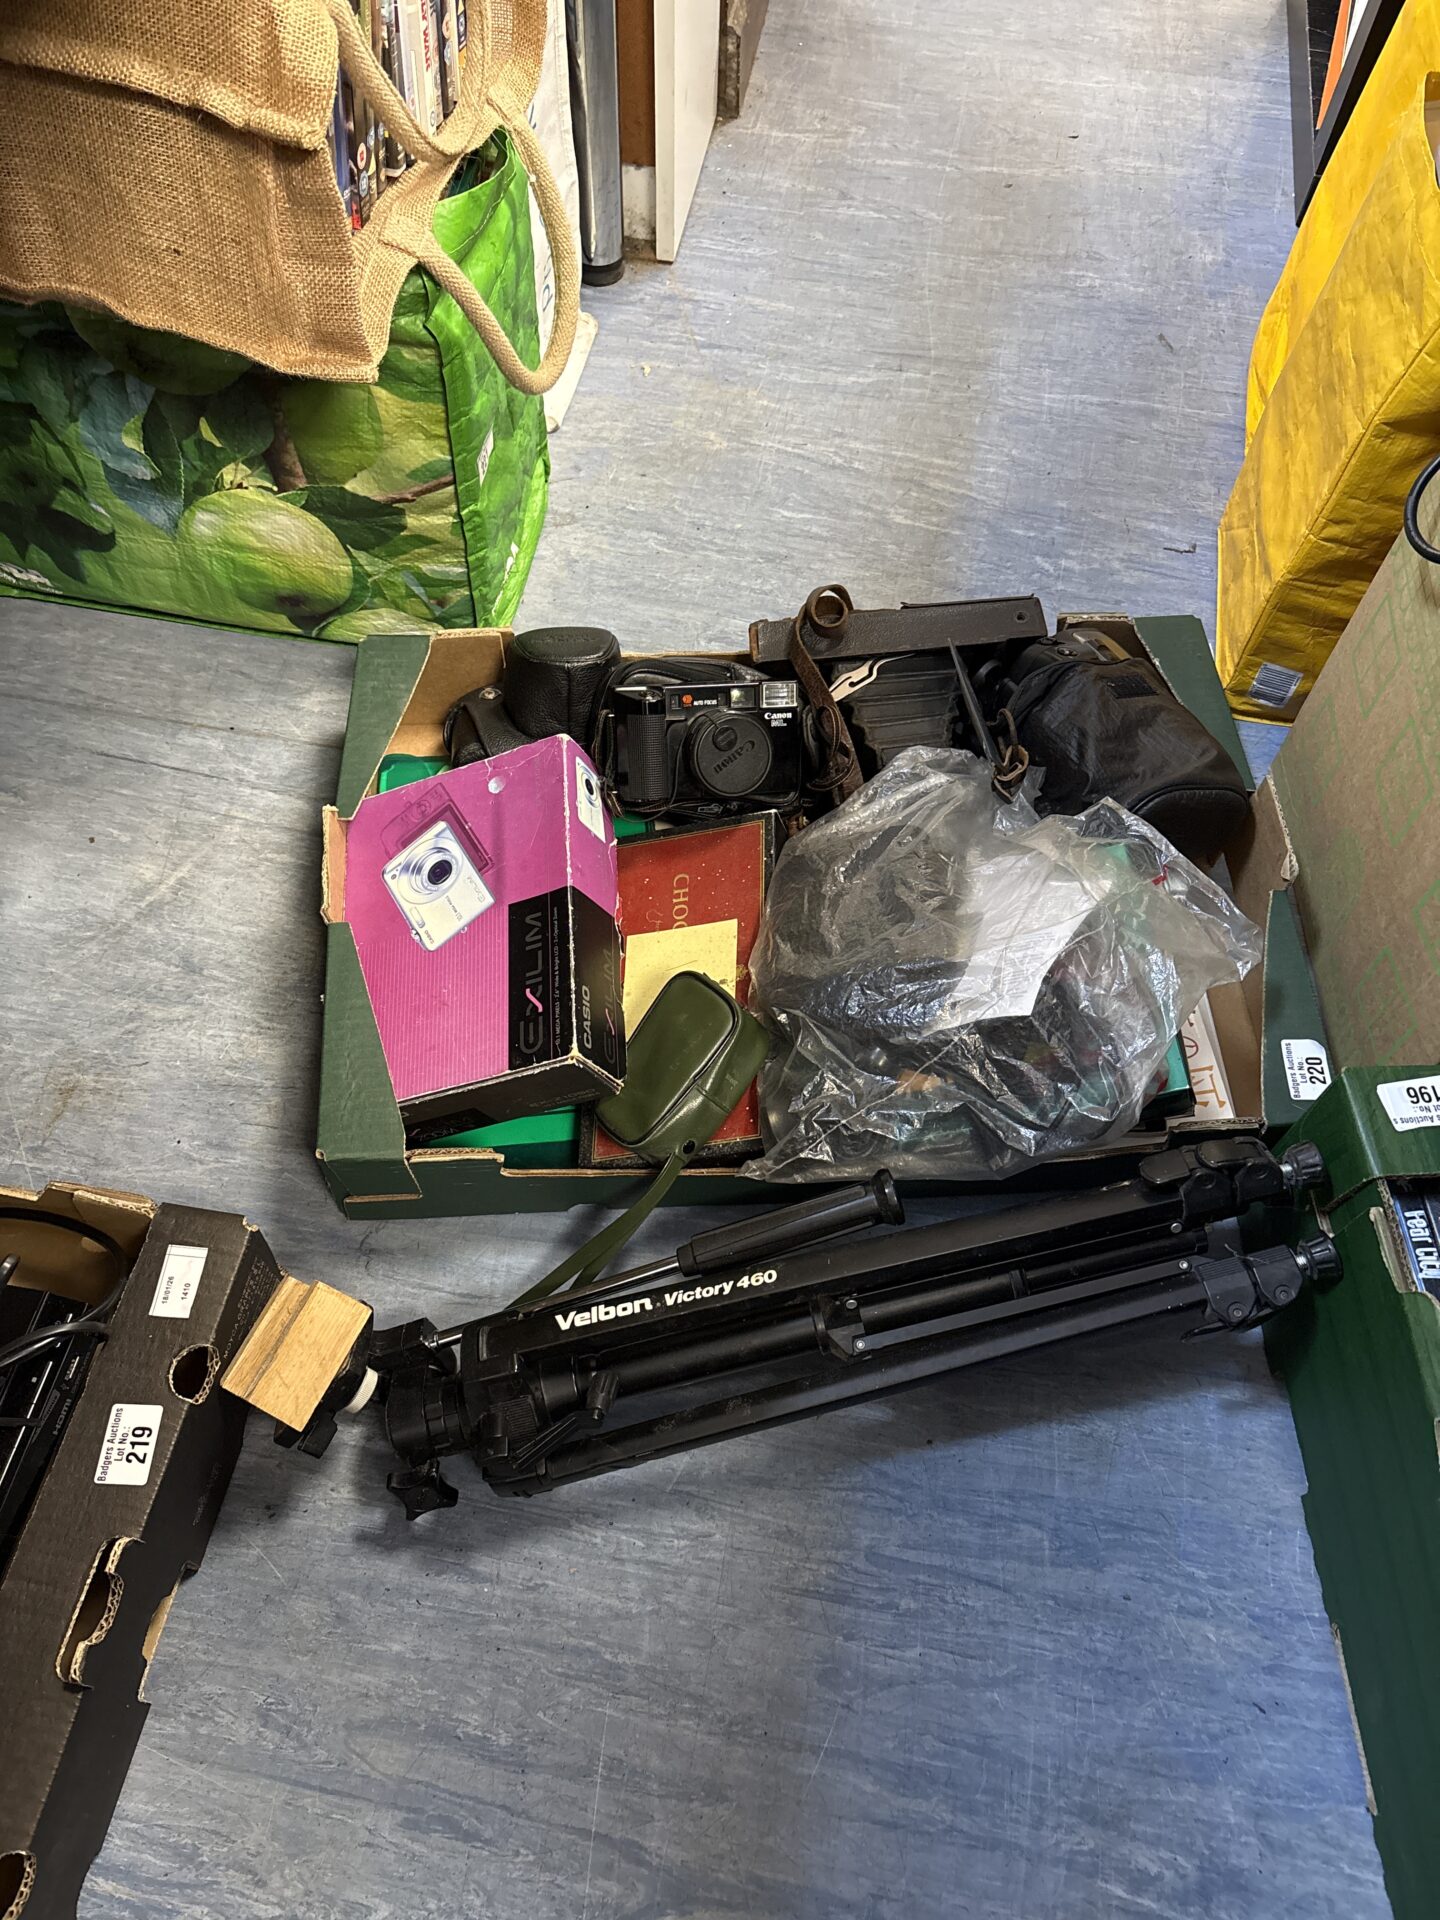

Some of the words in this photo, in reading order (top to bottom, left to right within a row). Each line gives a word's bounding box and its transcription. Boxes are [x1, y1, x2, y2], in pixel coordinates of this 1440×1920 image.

[713, 740, 755, 774] Canon
[519, 911, 544, 1055] EXILIM
[581, 984, 593, 1050] CASIO
[602, 949, 617, 1065] EXILIM
[1285, 1042, 1296, 1071] Auctions
[1305, 1057, 1326, 1085] 220
[1290, 1073, 1301, 1098] Badgers
[1407, 1085, 1440, 1105] 196
[1401, 1113, 1433, 1125] Auctions
[1404, 1210, 1433, 1246] Fear
[1414, 1245, 1440, 1280] City
[161, 1275, 176, 1306] 18/01/26
[181, 1282, 191, 1301] 1410
[554, 1297, 653, 1331] Velbon
[664, 1280, 734, 1307] Victory
[737, 1269, 778, 1290] 460
[224, 1323, 239, 1358] MOYCA
[237, 1280, 254, 1320] GRAPES
[52, 1397, 72, 1436] HDMI
[97, 1446, 114, 1483] Badgers
[108, 1407, 124, 1444] Auctions
[113, 1447, 125, 1463] Lot
[125, 1425, 153, 1465] 219
